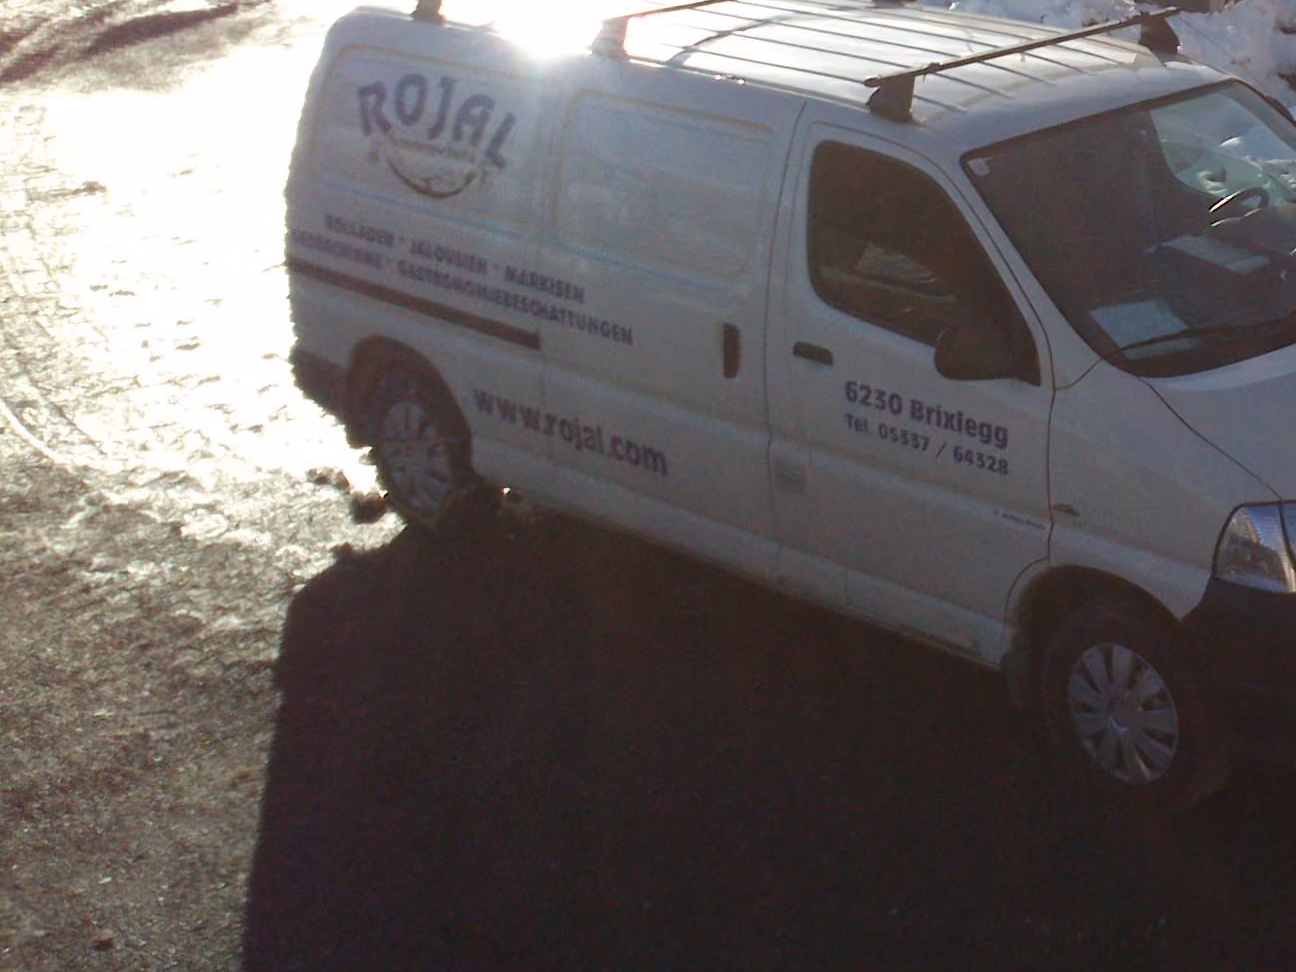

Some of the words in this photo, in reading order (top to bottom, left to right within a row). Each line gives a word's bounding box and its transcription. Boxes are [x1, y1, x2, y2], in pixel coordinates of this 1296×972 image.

[357, 73, 517, 169] ROJAL
[505, 264, 585, 303] MARKISEN
[472, 388, 669, 475] www.rojal.com
[845, 381, 902, 415] 6230
[910, 399, 1008, 449] Brixlegg
[878, 423, 930, 452] 05337
[953, 445, 1008, 475] 64328
